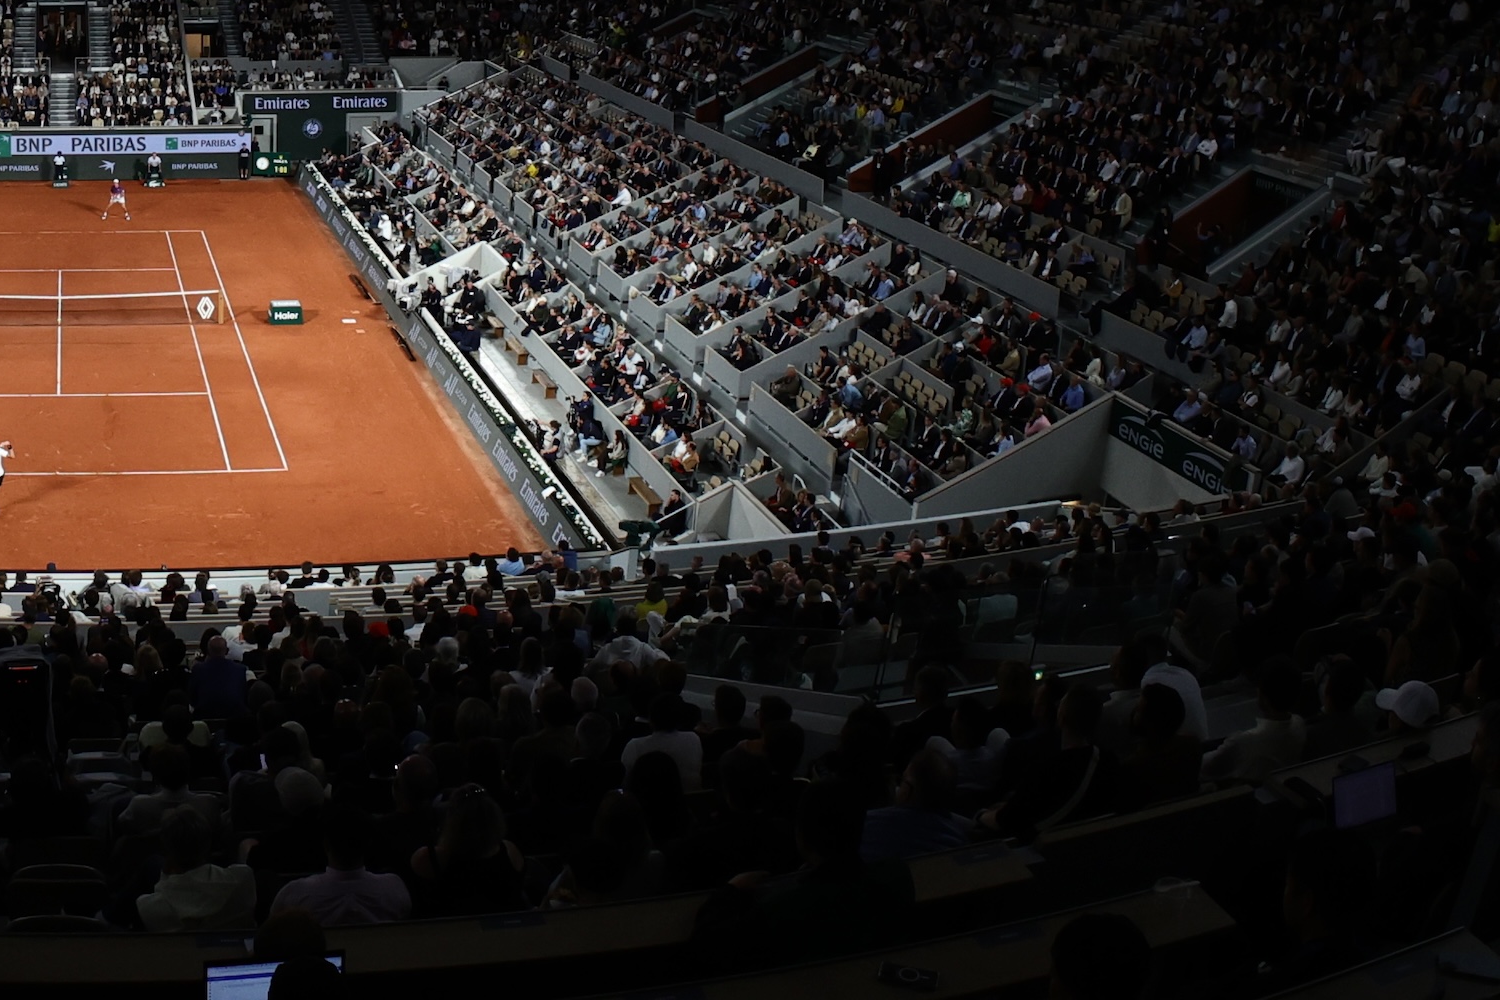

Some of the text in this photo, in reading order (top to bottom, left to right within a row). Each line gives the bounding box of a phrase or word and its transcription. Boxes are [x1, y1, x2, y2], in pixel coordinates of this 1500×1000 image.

[254, 97, 311, 110] Emirates
[333, 96, 388, 109] Emirates
[16, 137, 147, 153] BNP PARIBAS
[181, 139, 237, 148] BNP PARIBAS
[274, 311, 298, 320] Haier
[467, 403, 492, 443] Emirates
[492, 438, 519, 482] Emirates
[520, 477, 550, 526] Emirates
